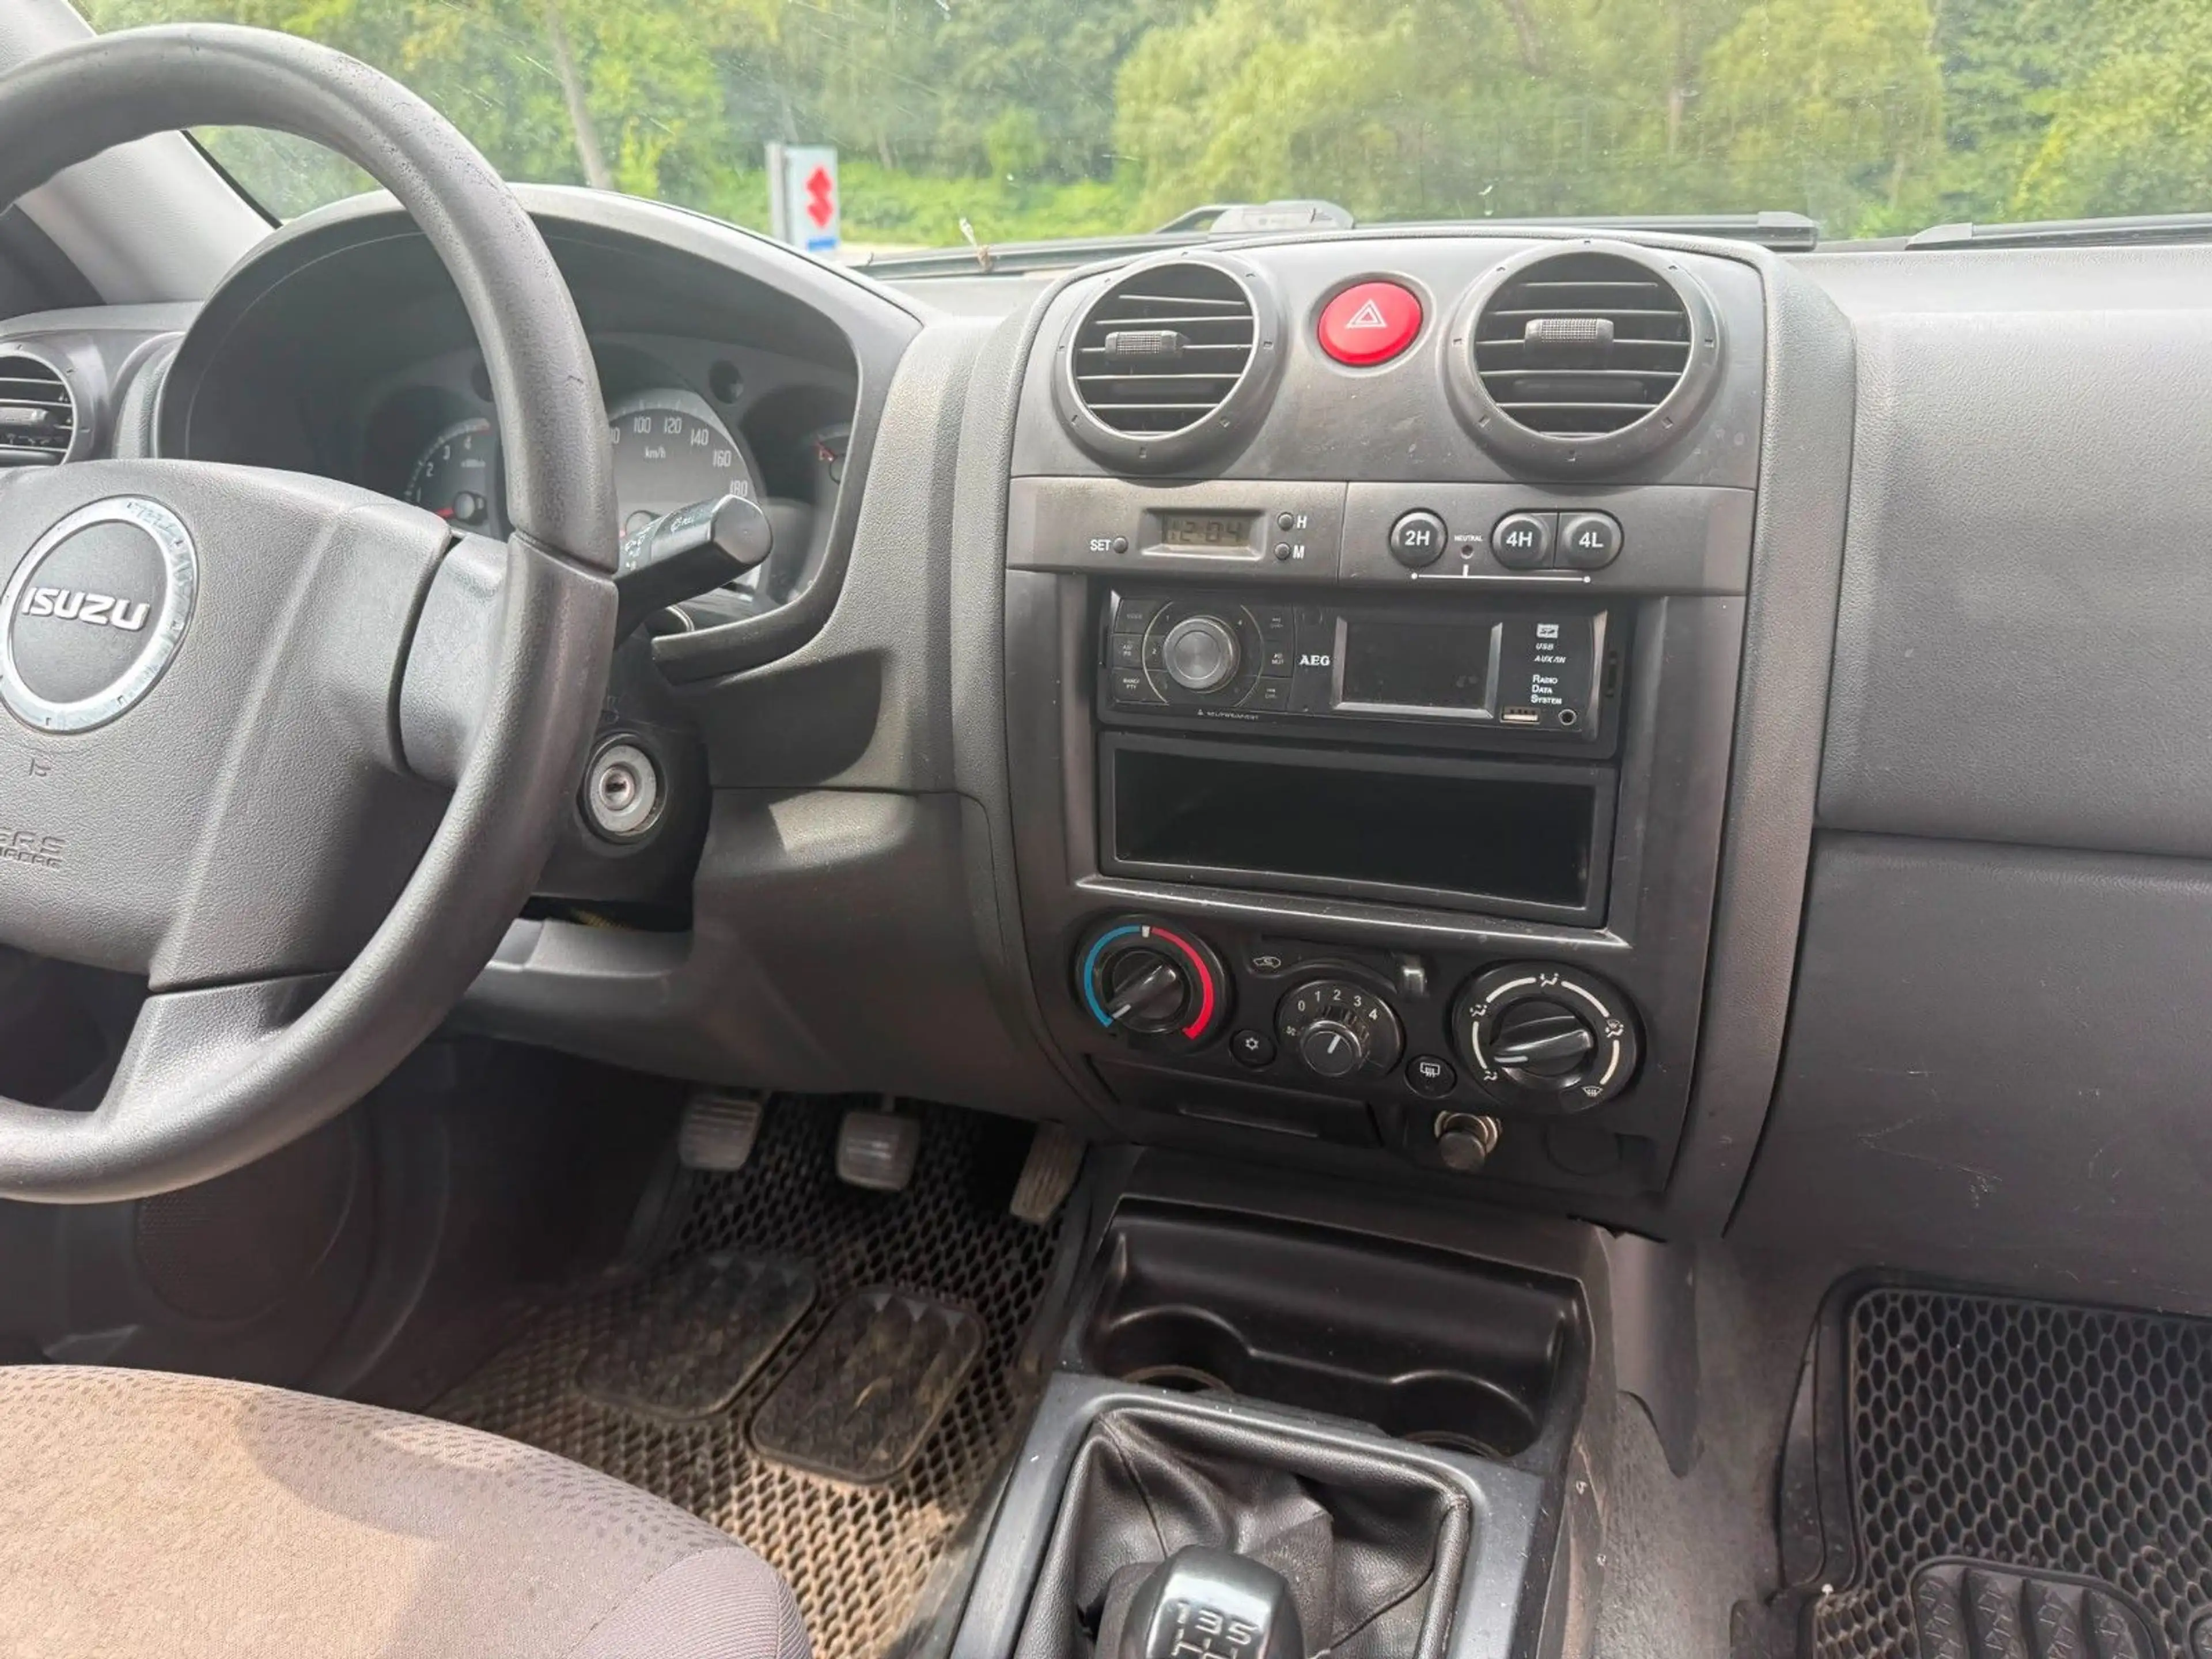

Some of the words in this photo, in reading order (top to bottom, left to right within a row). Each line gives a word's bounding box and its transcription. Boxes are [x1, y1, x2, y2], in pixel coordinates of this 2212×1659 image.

[634, 416, 652, 434] 100
[664, 417, 683, 434] 120
[691, 429, 709, 446] 140
[645, 446, 666, 459] km/h
[713, 449, 732, 468] 160
[729, 479, 747, 497] 180
[1297, 516, 1307, 529] H
[1090, 540, 1112, 551] SET
[1405, 531, 1430, 546] 2H
[1453, 534, 1483, 542] NEUTRAL
[1506, 532, 1533, 547] 4H
[1578, 532, 1604, 548] 4L
[1293, 546, 1305, 559] M
[21, 586, 150, 631] ISUZU
[1535, 642, 1554, 650] USB
[1299, 654, 1331, 666] AEG
[1297, 999, 1306, 1012] 0
[1314, 990, 1321, 1002] 1
[1333, 988, 1342, 1001] 2
[1354, 995, 1362, 1007] 3
[1369, 1008, 1378, 1021] 4
[1177, 1600, 1191, 1624] 1
[1194, 1609, 1224, 1637] 3
[1225, 1620, 1260, 1646] 5
